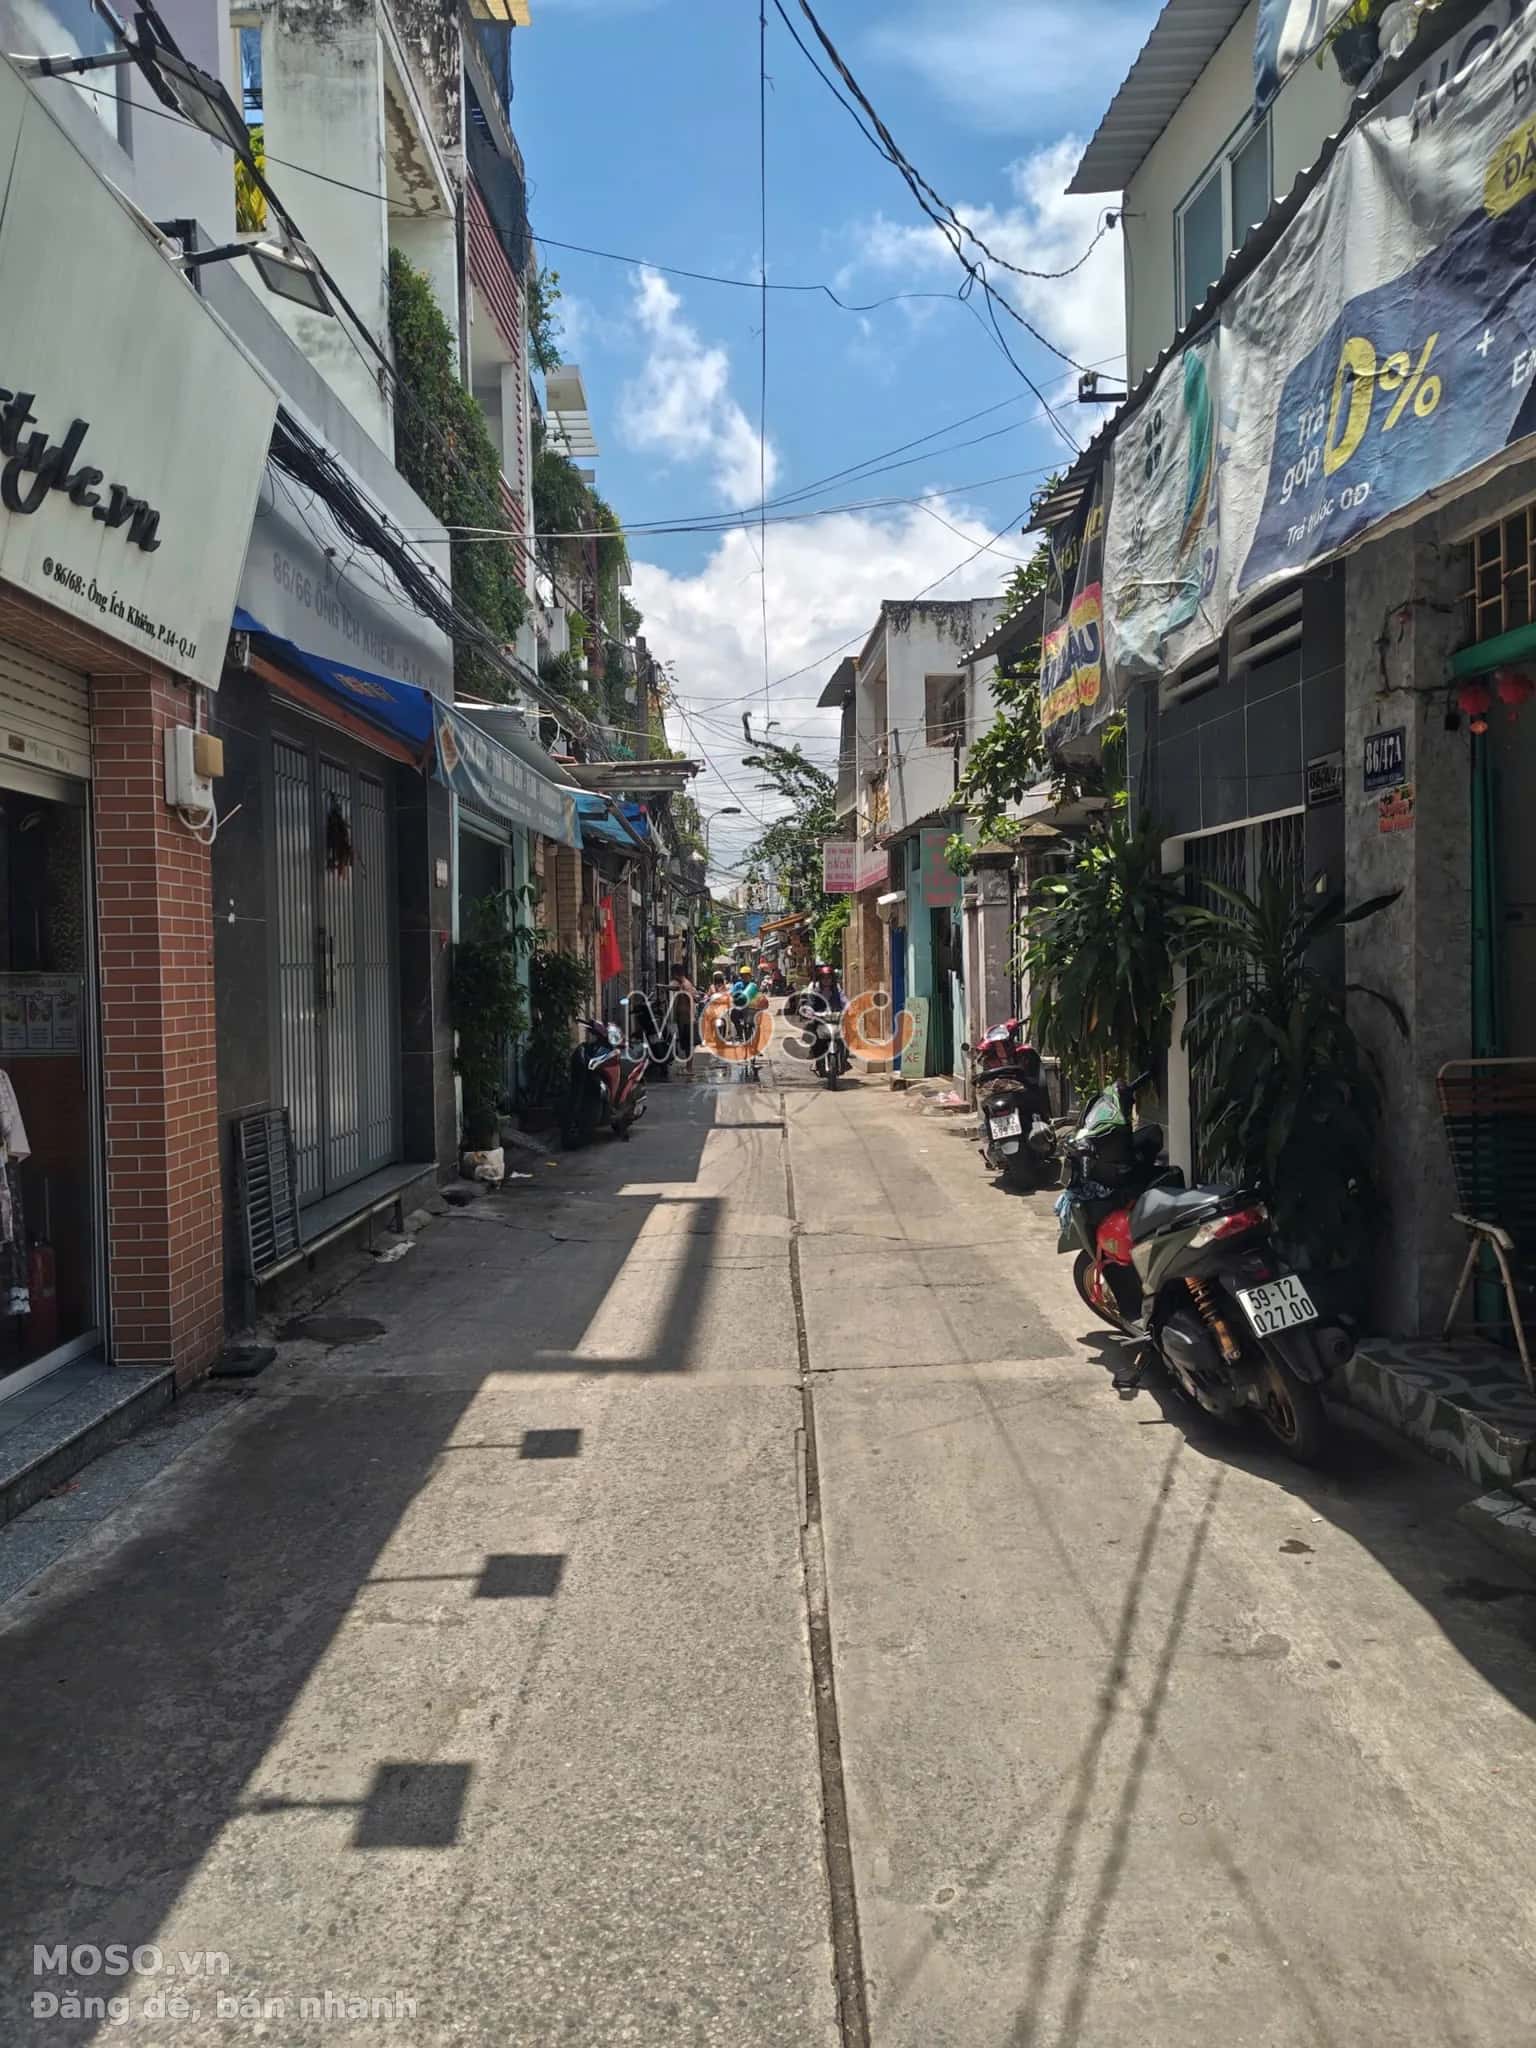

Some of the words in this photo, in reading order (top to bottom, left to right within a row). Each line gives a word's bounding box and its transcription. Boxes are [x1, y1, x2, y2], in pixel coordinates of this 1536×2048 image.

[1324, 332, 1441, 477] 0%
[53, 562, 86, 597] 86/68:
[87, 577, 108, 613] Ông
[109, 590, 125, 619] Ích
[1247, 1279, 1299, 1310] 59-T2
[1253, 1297, 1315, 1333] 027.00
